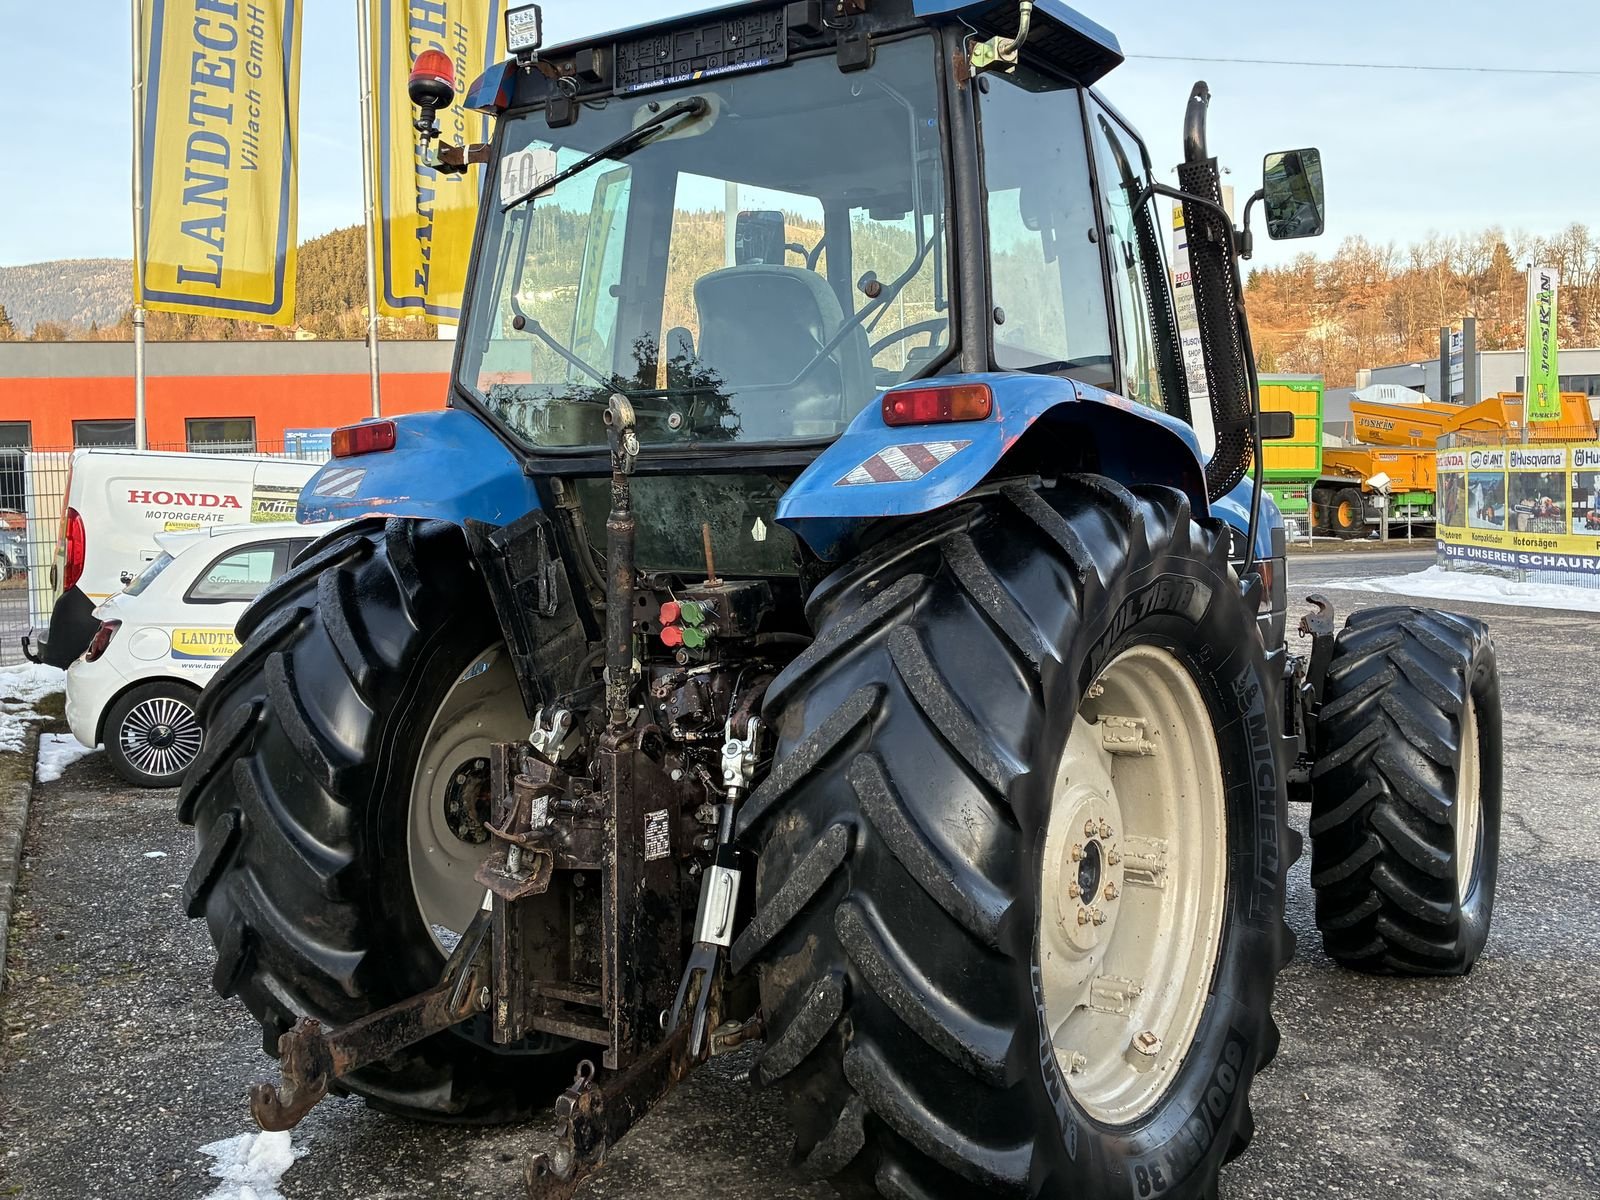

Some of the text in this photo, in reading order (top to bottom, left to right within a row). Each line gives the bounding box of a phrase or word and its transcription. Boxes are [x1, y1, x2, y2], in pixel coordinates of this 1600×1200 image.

[240, 3, 265, 172] Villach GmbH
[633, 80, 665, 92] Landtechnik
[667, 74, 690, 84] VILLACH
[446, 99, 465, 183] Vach
[503, 152, 534, 196] 40
[1516, 450, 1562, 468] Husqvarna
[127, 490, 243, 509] HONDA
[145, 510, 225, 523] MOTORGERÄTE
[1512, 536, 1559, 550] Motorsägen
[1446, 546, 1465, 556] SIE
[1467, 548, 1515, 563] UNSEREN
